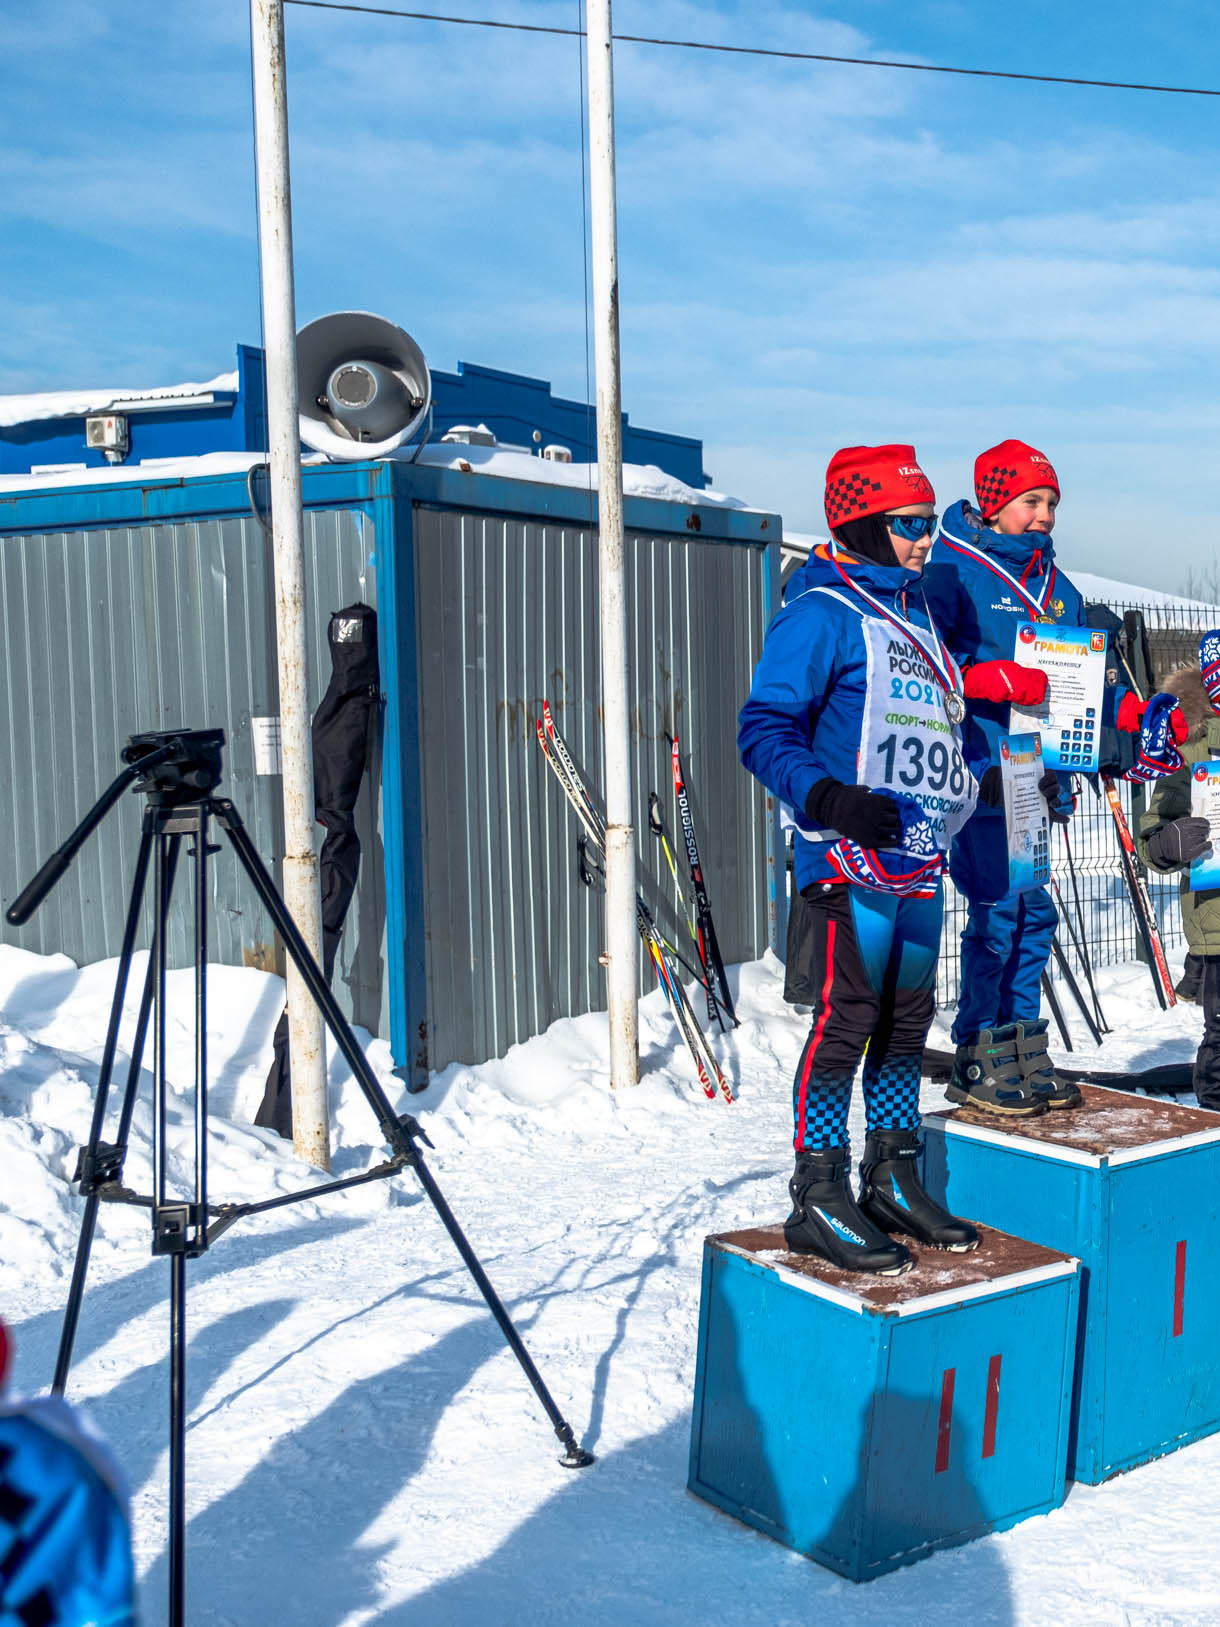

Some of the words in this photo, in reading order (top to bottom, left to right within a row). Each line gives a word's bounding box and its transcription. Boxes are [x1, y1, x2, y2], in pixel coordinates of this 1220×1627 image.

[991, 603, 1025, 613] NOVOSKI
[1033, 641, 1089, 657] ГРАМОТА
[889, 677, 942, 708] 2021
[885, 713, 920, 727] СПОРТ
[830, 1217, 866, 1247] salomon
